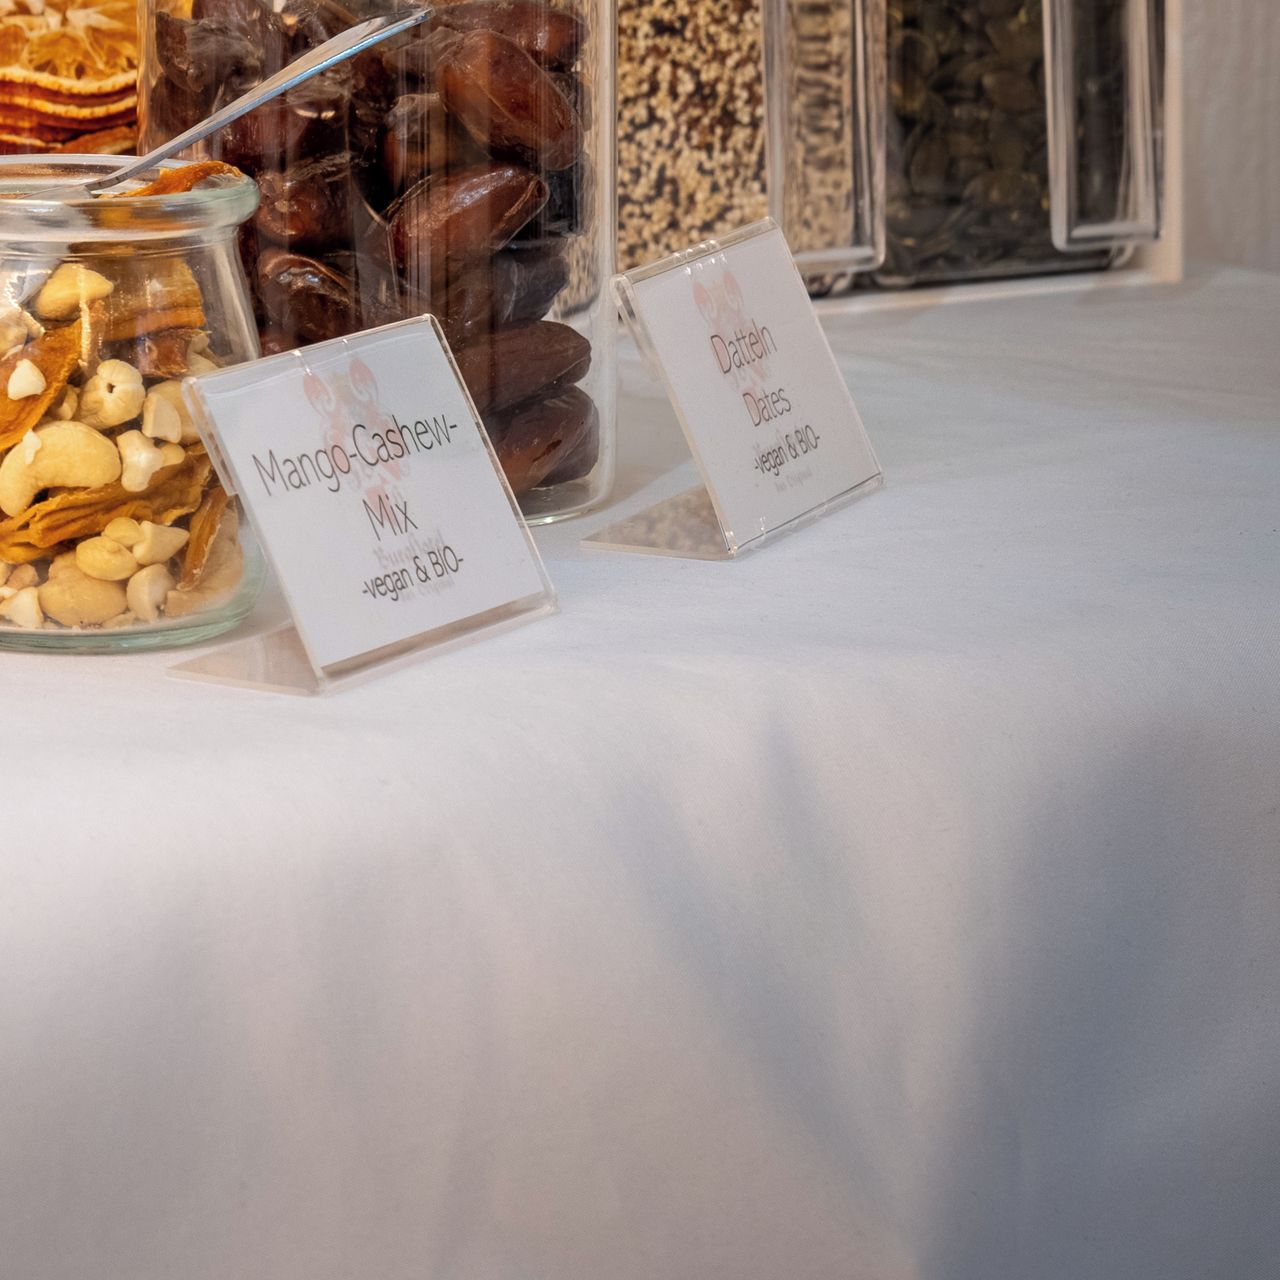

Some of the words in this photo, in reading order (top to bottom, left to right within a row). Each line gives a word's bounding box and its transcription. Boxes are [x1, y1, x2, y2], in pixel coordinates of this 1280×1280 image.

[710, 318, 778, 375] Datteln
[742, 387, 792, 427] Dates
[252, 414, 458, 497] Mango-Cashew-
[785, 434, 800, 459] &
[362, 494, 419, 541] Mix
[362, 568, 415, 602] -vegan
[413, 555, 431, 583] &
[427, 545, 464, 577] BIO-
